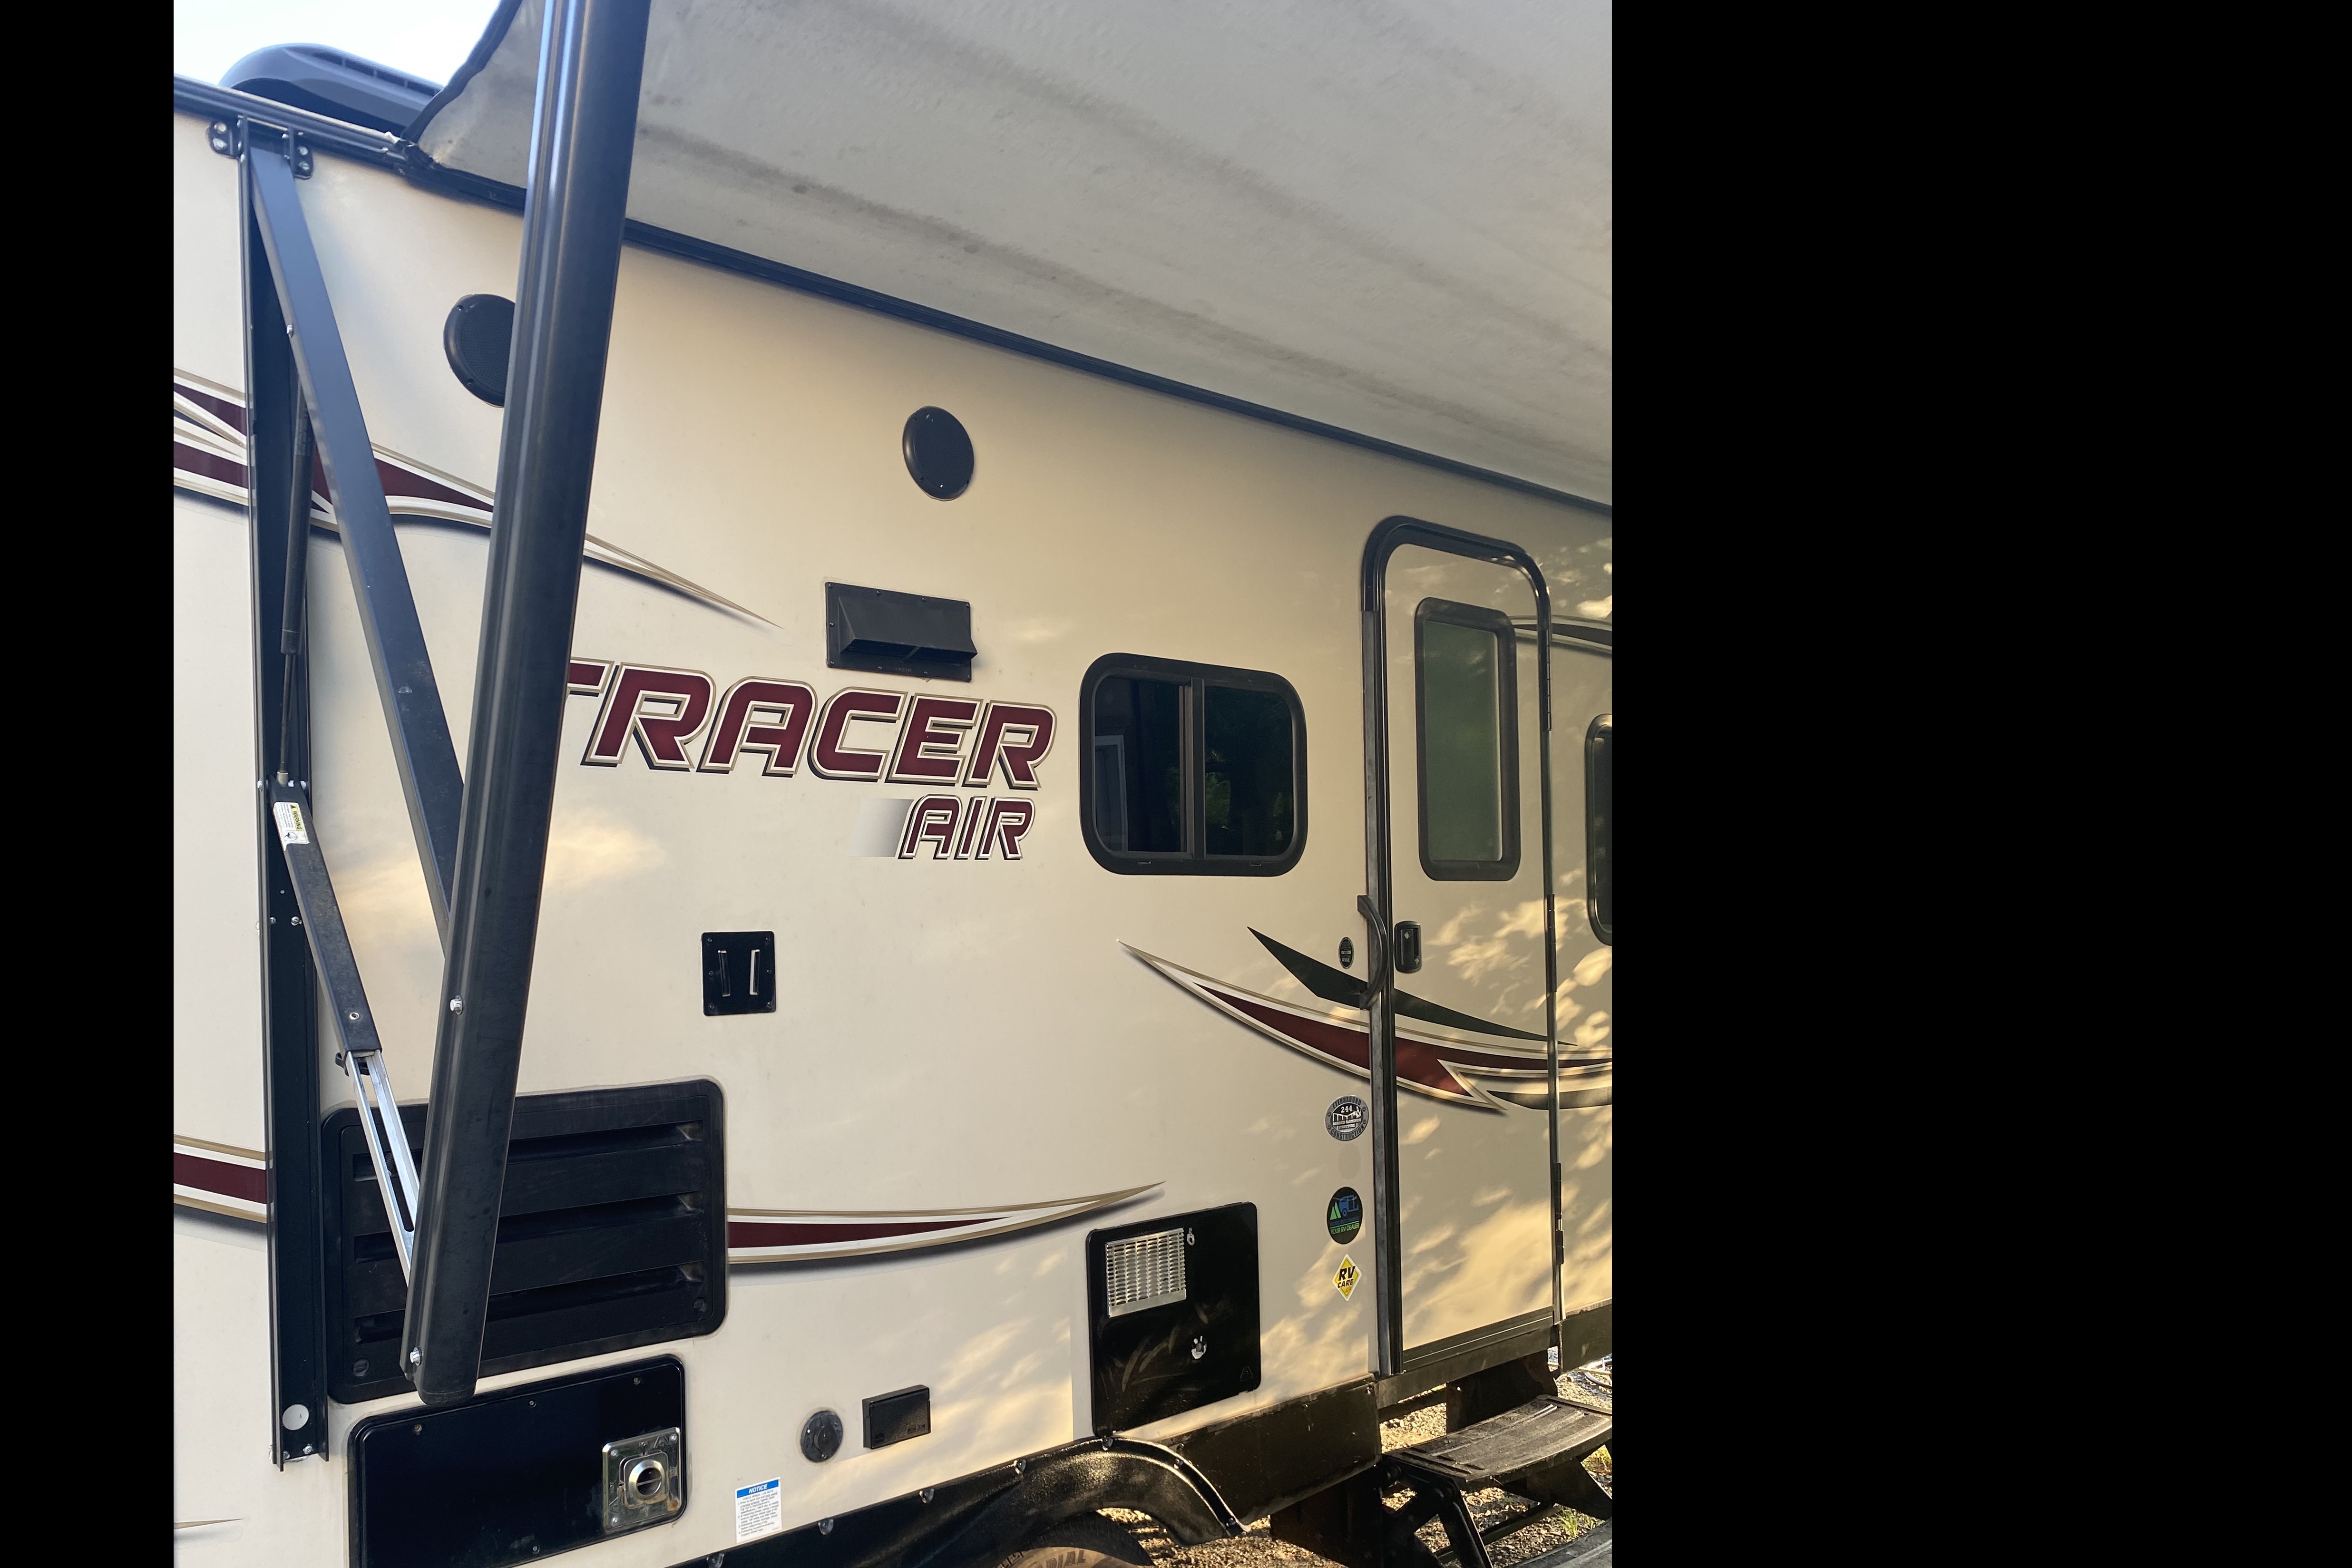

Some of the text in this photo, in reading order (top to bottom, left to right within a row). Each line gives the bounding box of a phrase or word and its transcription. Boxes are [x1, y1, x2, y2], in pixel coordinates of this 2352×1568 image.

[293, 811, 302, 830] WARNING
[898, 794, 1035, 860] AIR
[1330, 1124, 1365, 1140] CONSTRUCTION
[1347, 1223, 1359, 1231] DEALER
[1338, 1266, 1356, 1281] RV
[1337, 1279, 1354, 1288] CARE
[749, 1484, 767, 1494] NOTICE
